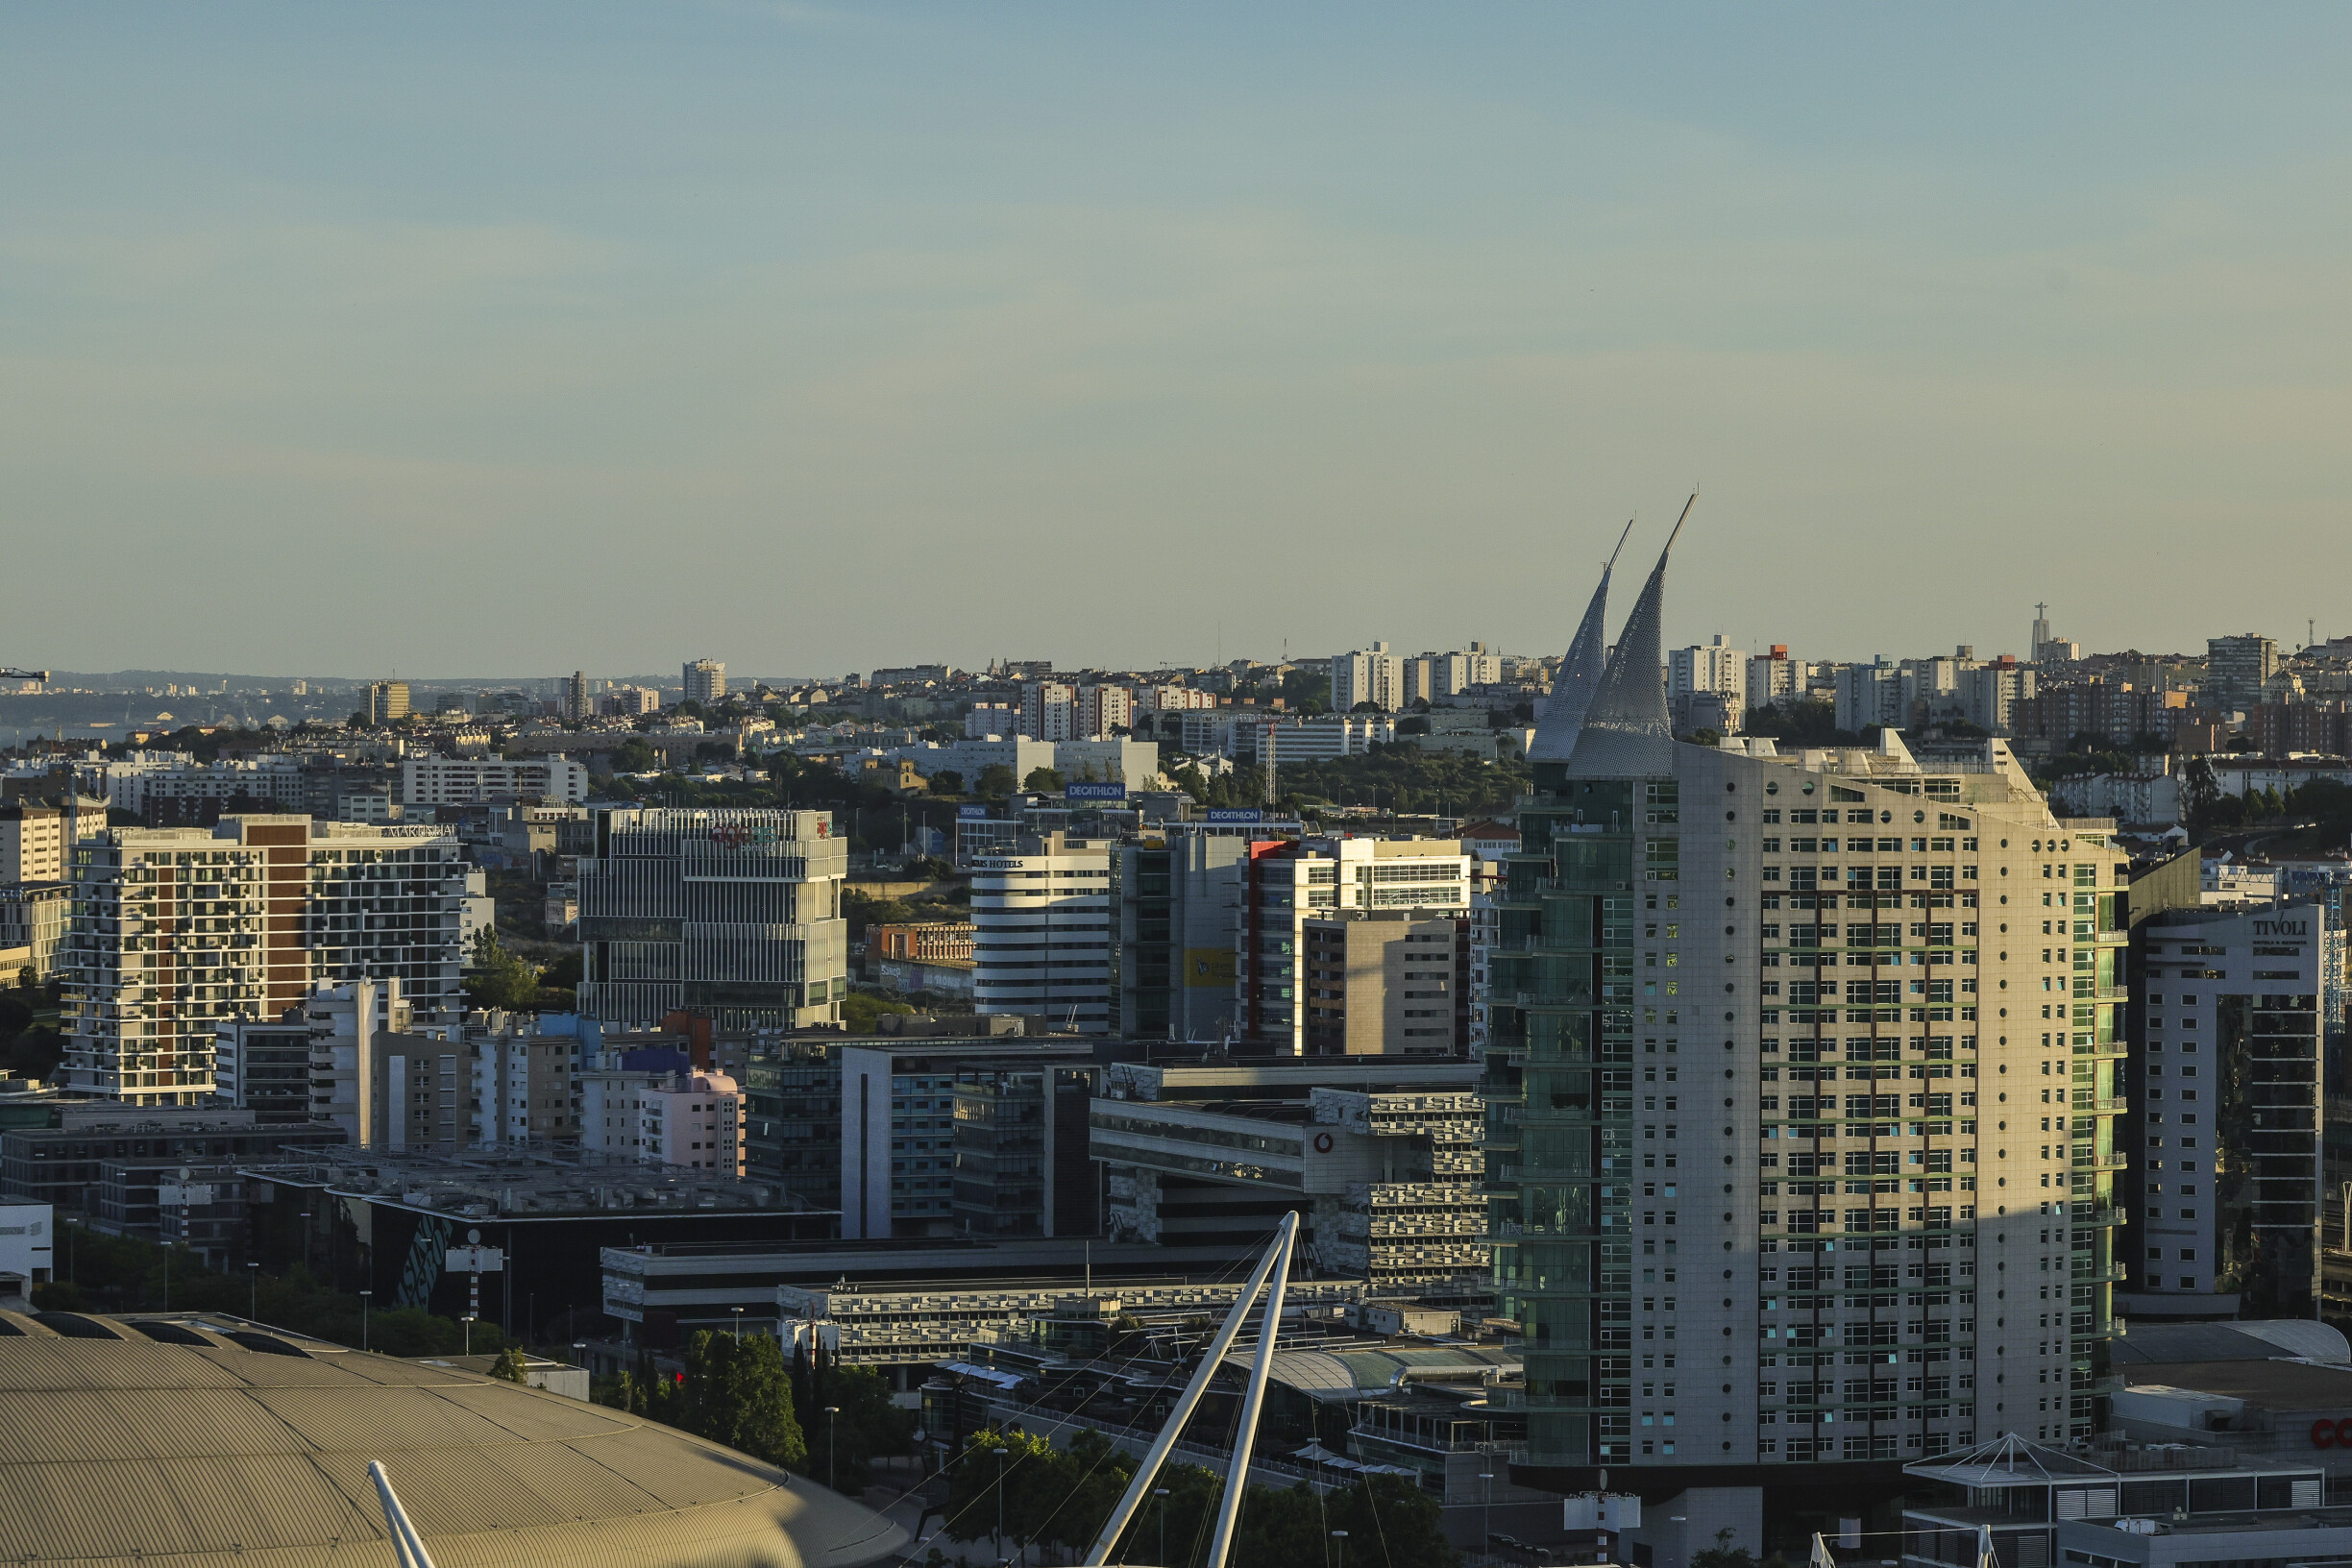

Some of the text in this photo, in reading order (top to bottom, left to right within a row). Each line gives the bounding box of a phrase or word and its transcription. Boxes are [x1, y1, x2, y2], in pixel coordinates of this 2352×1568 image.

[1069, 786, 1122, 796] DECATHLON
[961, 807, 986, 816] DECATHLON
[1211, 811, 1258, 820] DECATHLON
[713, 826, 777, 849] ageas
[741, 845, 776, 853] portugal
[2253, 911, 2307, 935] TIVOLI
